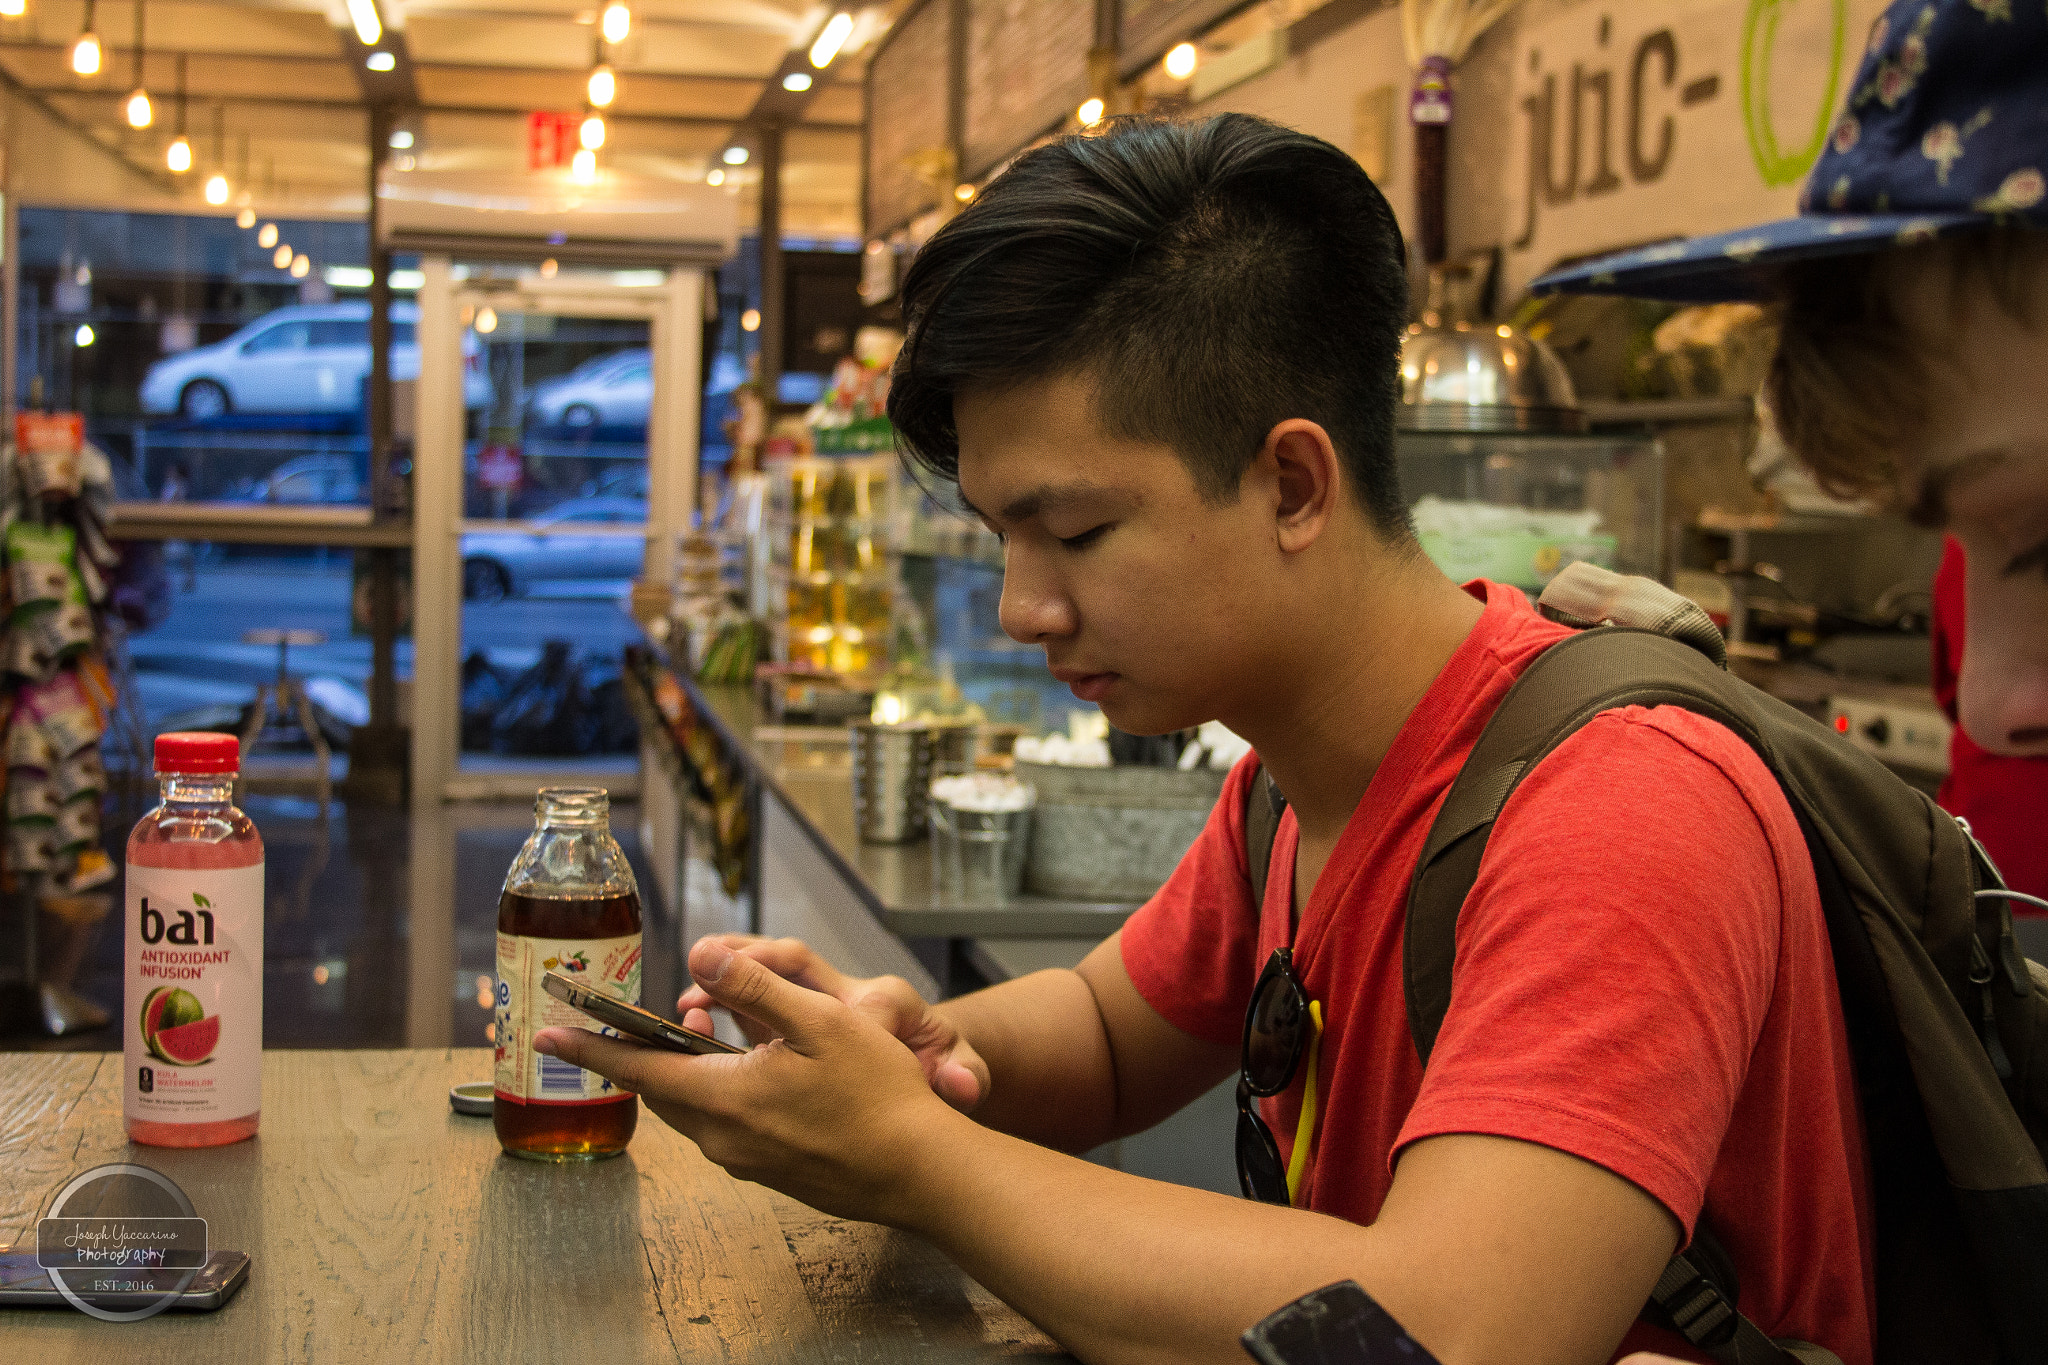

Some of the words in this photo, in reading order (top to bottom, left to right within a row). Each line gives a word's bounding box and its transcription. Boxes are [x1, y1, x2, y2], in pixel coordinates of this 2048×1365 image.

[141, 892, 214, 946] bai
[141, 949, 230, 965] ANTIOXIDANT
[140, 965, 202, 980] INFUSION
[156, 1079, 214, 1088] WATERMELON
